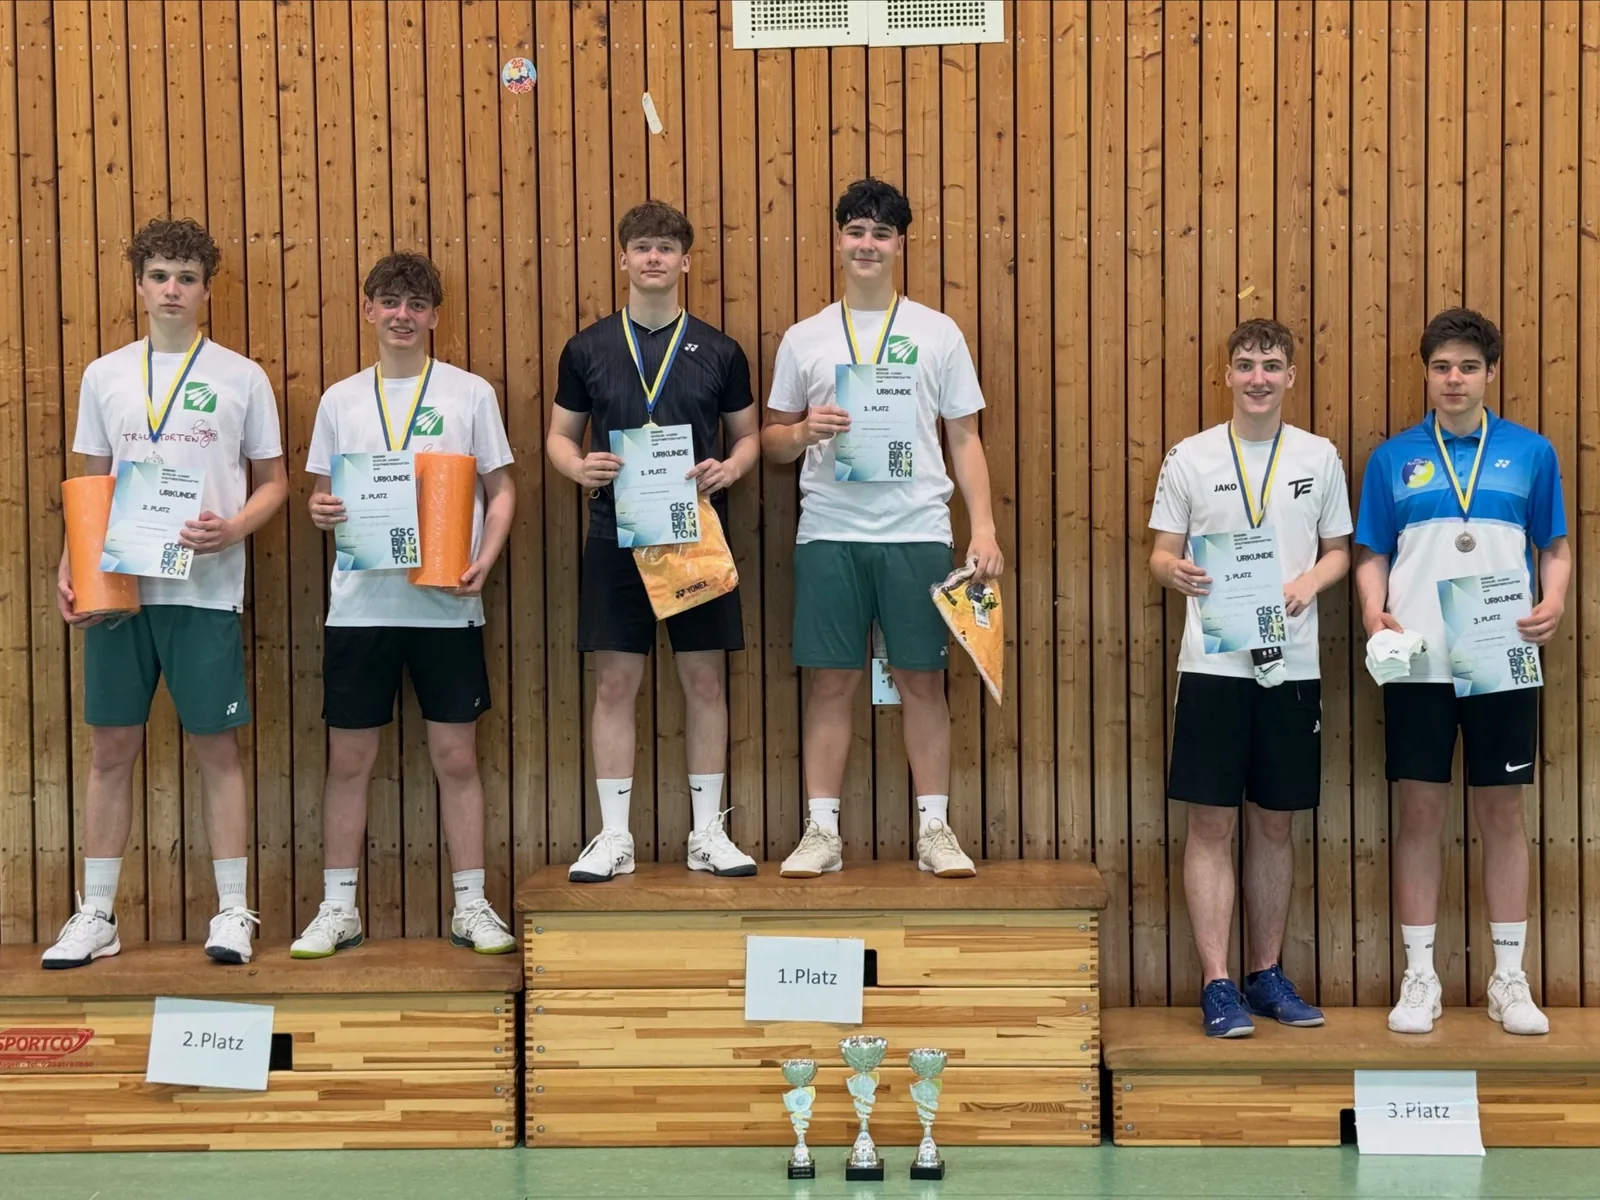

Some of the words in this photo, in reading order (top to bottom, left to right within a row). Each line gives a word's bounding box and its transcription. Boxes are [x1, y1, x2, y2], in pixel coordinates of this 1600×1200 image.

[876, 388, 912, 396] URKUNDE
[652, 449, 689, 459] URKUNDE
[648, 468, 667, 476] PLATZ
[888, 468, 913, 478] TON
[373, 474, 411, 483] URKUNDE
[1214, 483, 1237, 492] JAKO
[159, 488, 199, 500] URKUNDE
[368, 492, 388, 500] PLATZ
[150, 505, 171, 514] PLATZ
[672, 529, 698, 540] TON
[392, 555, 418, 564] TON
[1236, 550, 1275, 562] URKUNDE
[160, 566, 187, 576] TON
[1232, 572, 1252, 580] PLATZ
[1484, 592, 1524, 605] URKUNDE
[1482, 614, 1502, 622] PLATZ
[1260, 632, 1286, 644] TON
[1512, 674, 1540, 686] TON
[777, 968, 838, 986] 1.Platz
[182, 1030, 244, 1051] 2.Platz
[1387, 1102, 1450, 1119] 3.Platz
